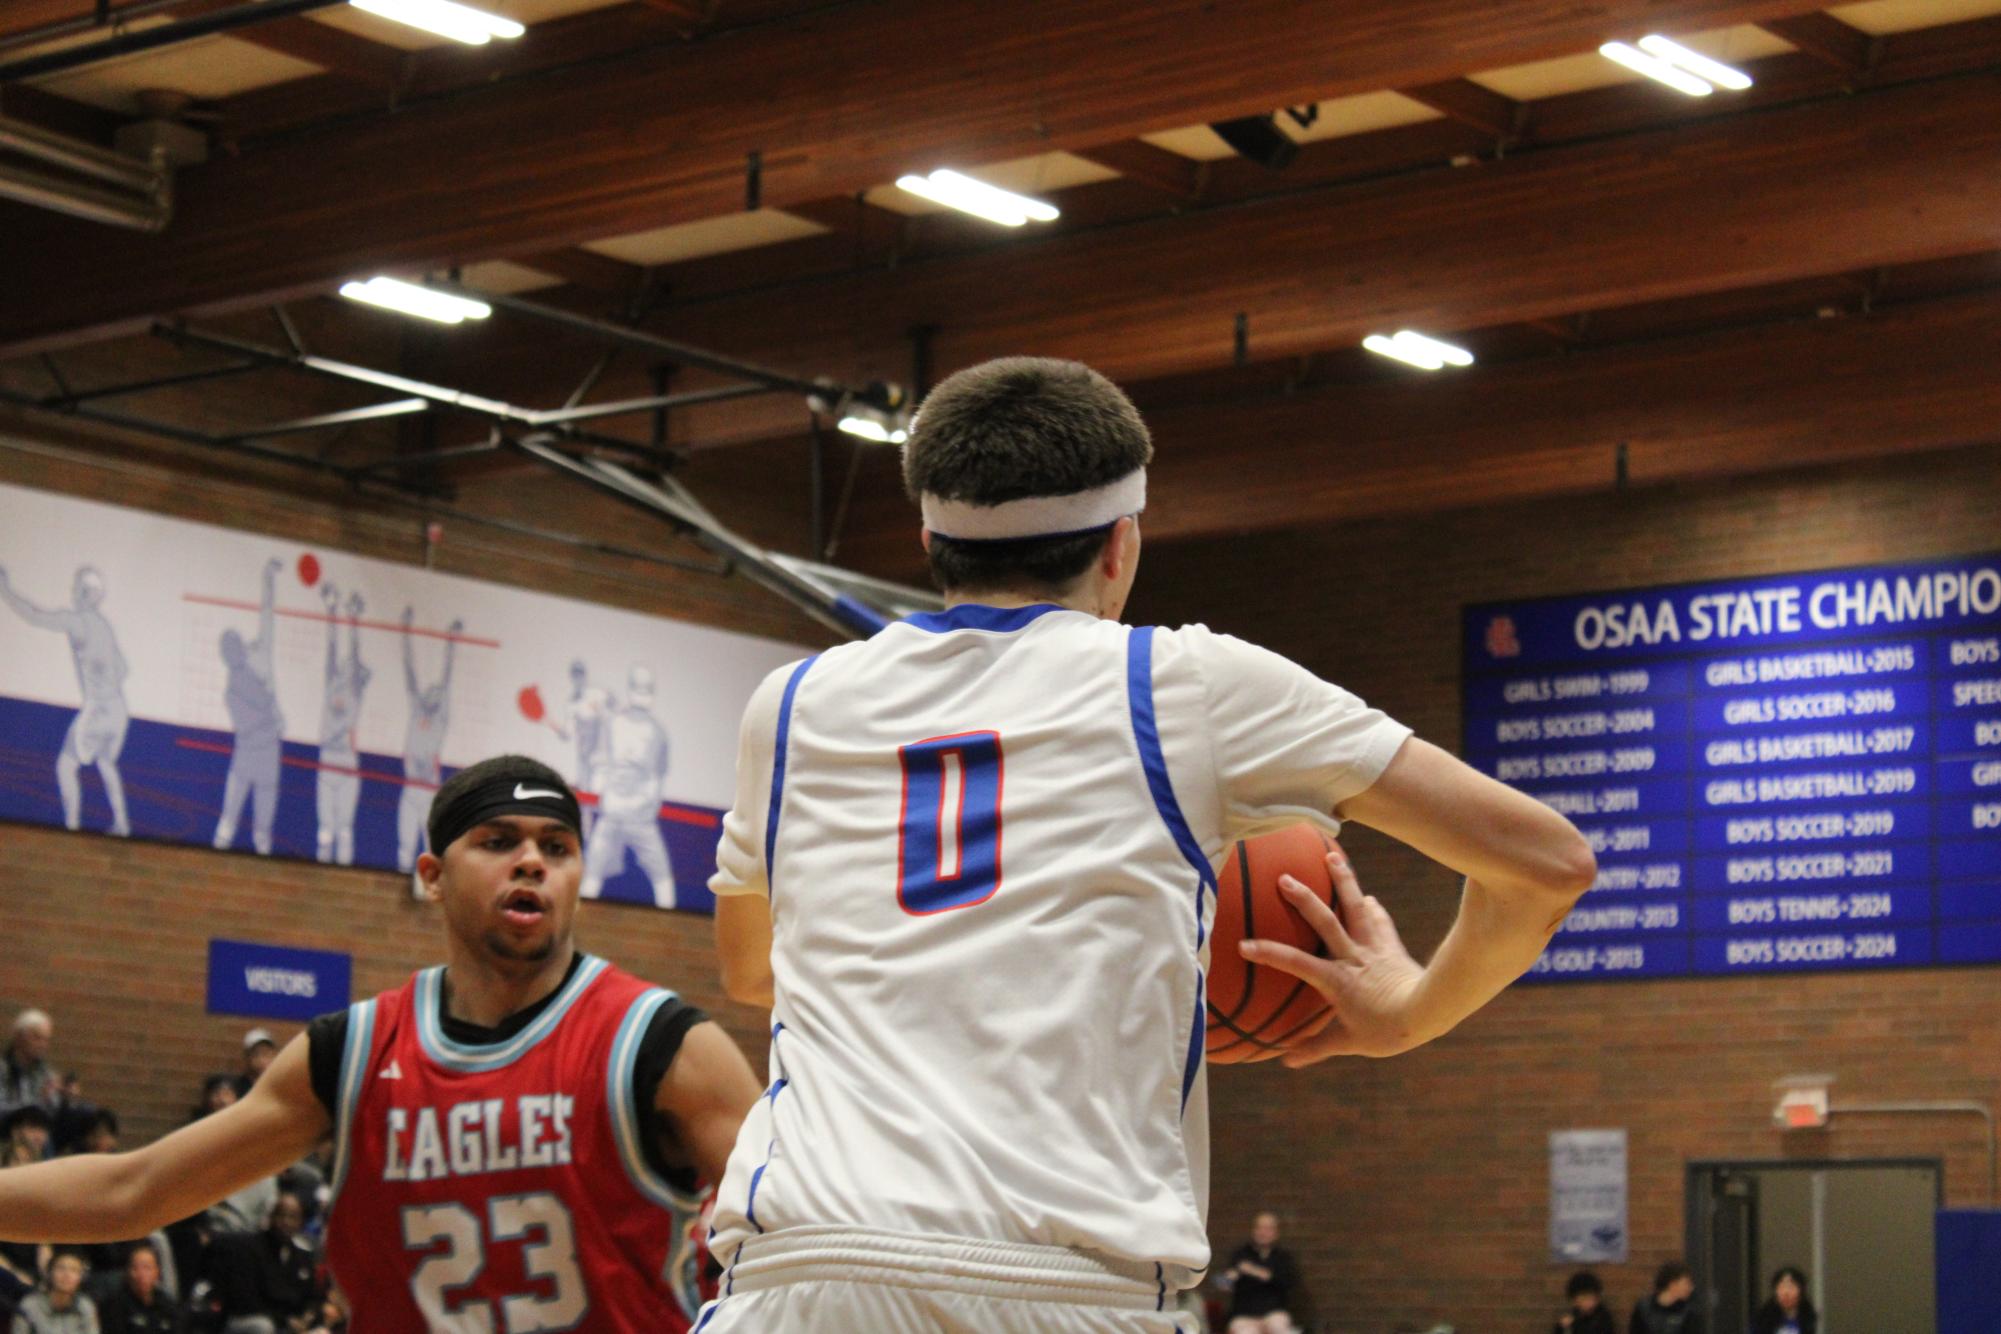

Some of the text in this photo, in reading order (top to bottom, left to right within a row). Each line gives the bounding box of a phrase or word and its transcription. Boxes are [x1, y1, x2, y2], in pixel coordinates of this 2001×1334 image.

[1575, 569, 2001, 650] OSAA STATE CHAMPIO
[1950, 637, 2000, 666] BOYS
[1705, 658, 1757, 686] GIRLS
[1724, 697, 1776, 725] GIRLS
[1497, 718, 1540, 742] BOYS
[1705, 738, 1757, 766] GIRLS
[1705, 778, 1757, 806] GIRLS
[897, 729, 1004, 917] 0
[1726, 818, 1774, 844] BOYS
[1726, 857, 1774, 884] BOYS
[1728, 897, 1775, 924] BOYS
[1726, 938, 1774, 965] BOYS
[244, 966, 317, 997] VISITORS
[383, 1092, 574, 1181] EAGLES
[401, 1190, 589, 1334] 23
